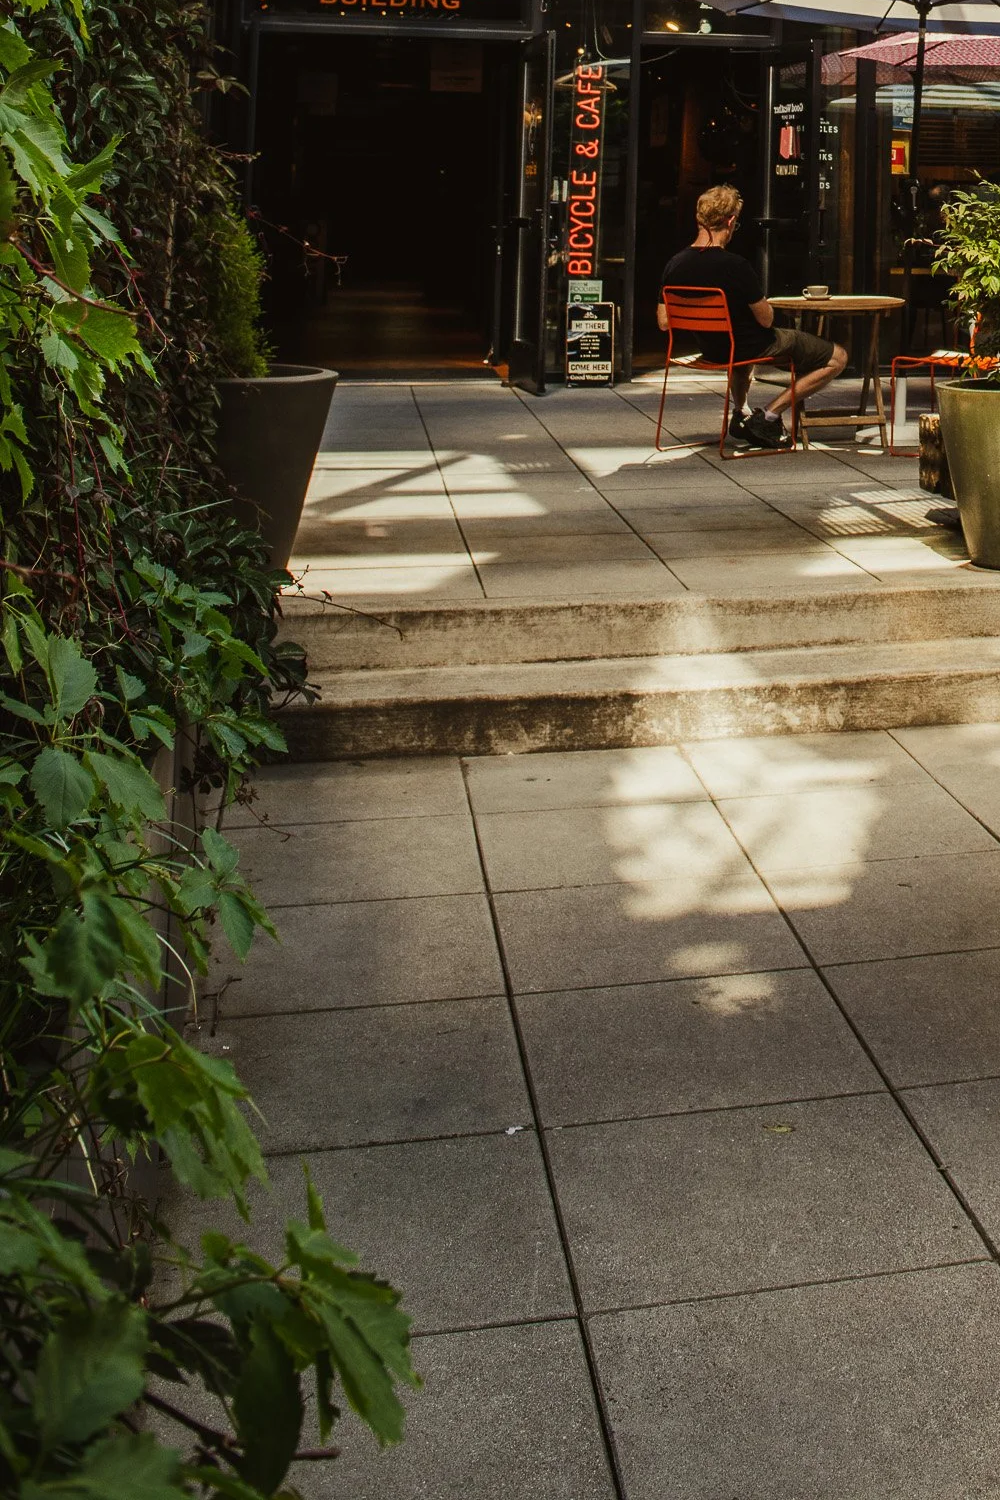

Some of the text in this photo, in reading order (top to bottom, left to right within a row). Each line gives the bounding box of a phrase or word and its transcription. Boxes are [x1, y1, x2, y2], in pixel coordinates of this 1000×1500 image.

[575, 64, 603, 130] CAFE
[575, 138, 599, 158] &
[568, 169, 597, 276] BICYCLE
[585, 322, 606, 330] THERE
[570, 363, 610, 372] COME HERE
